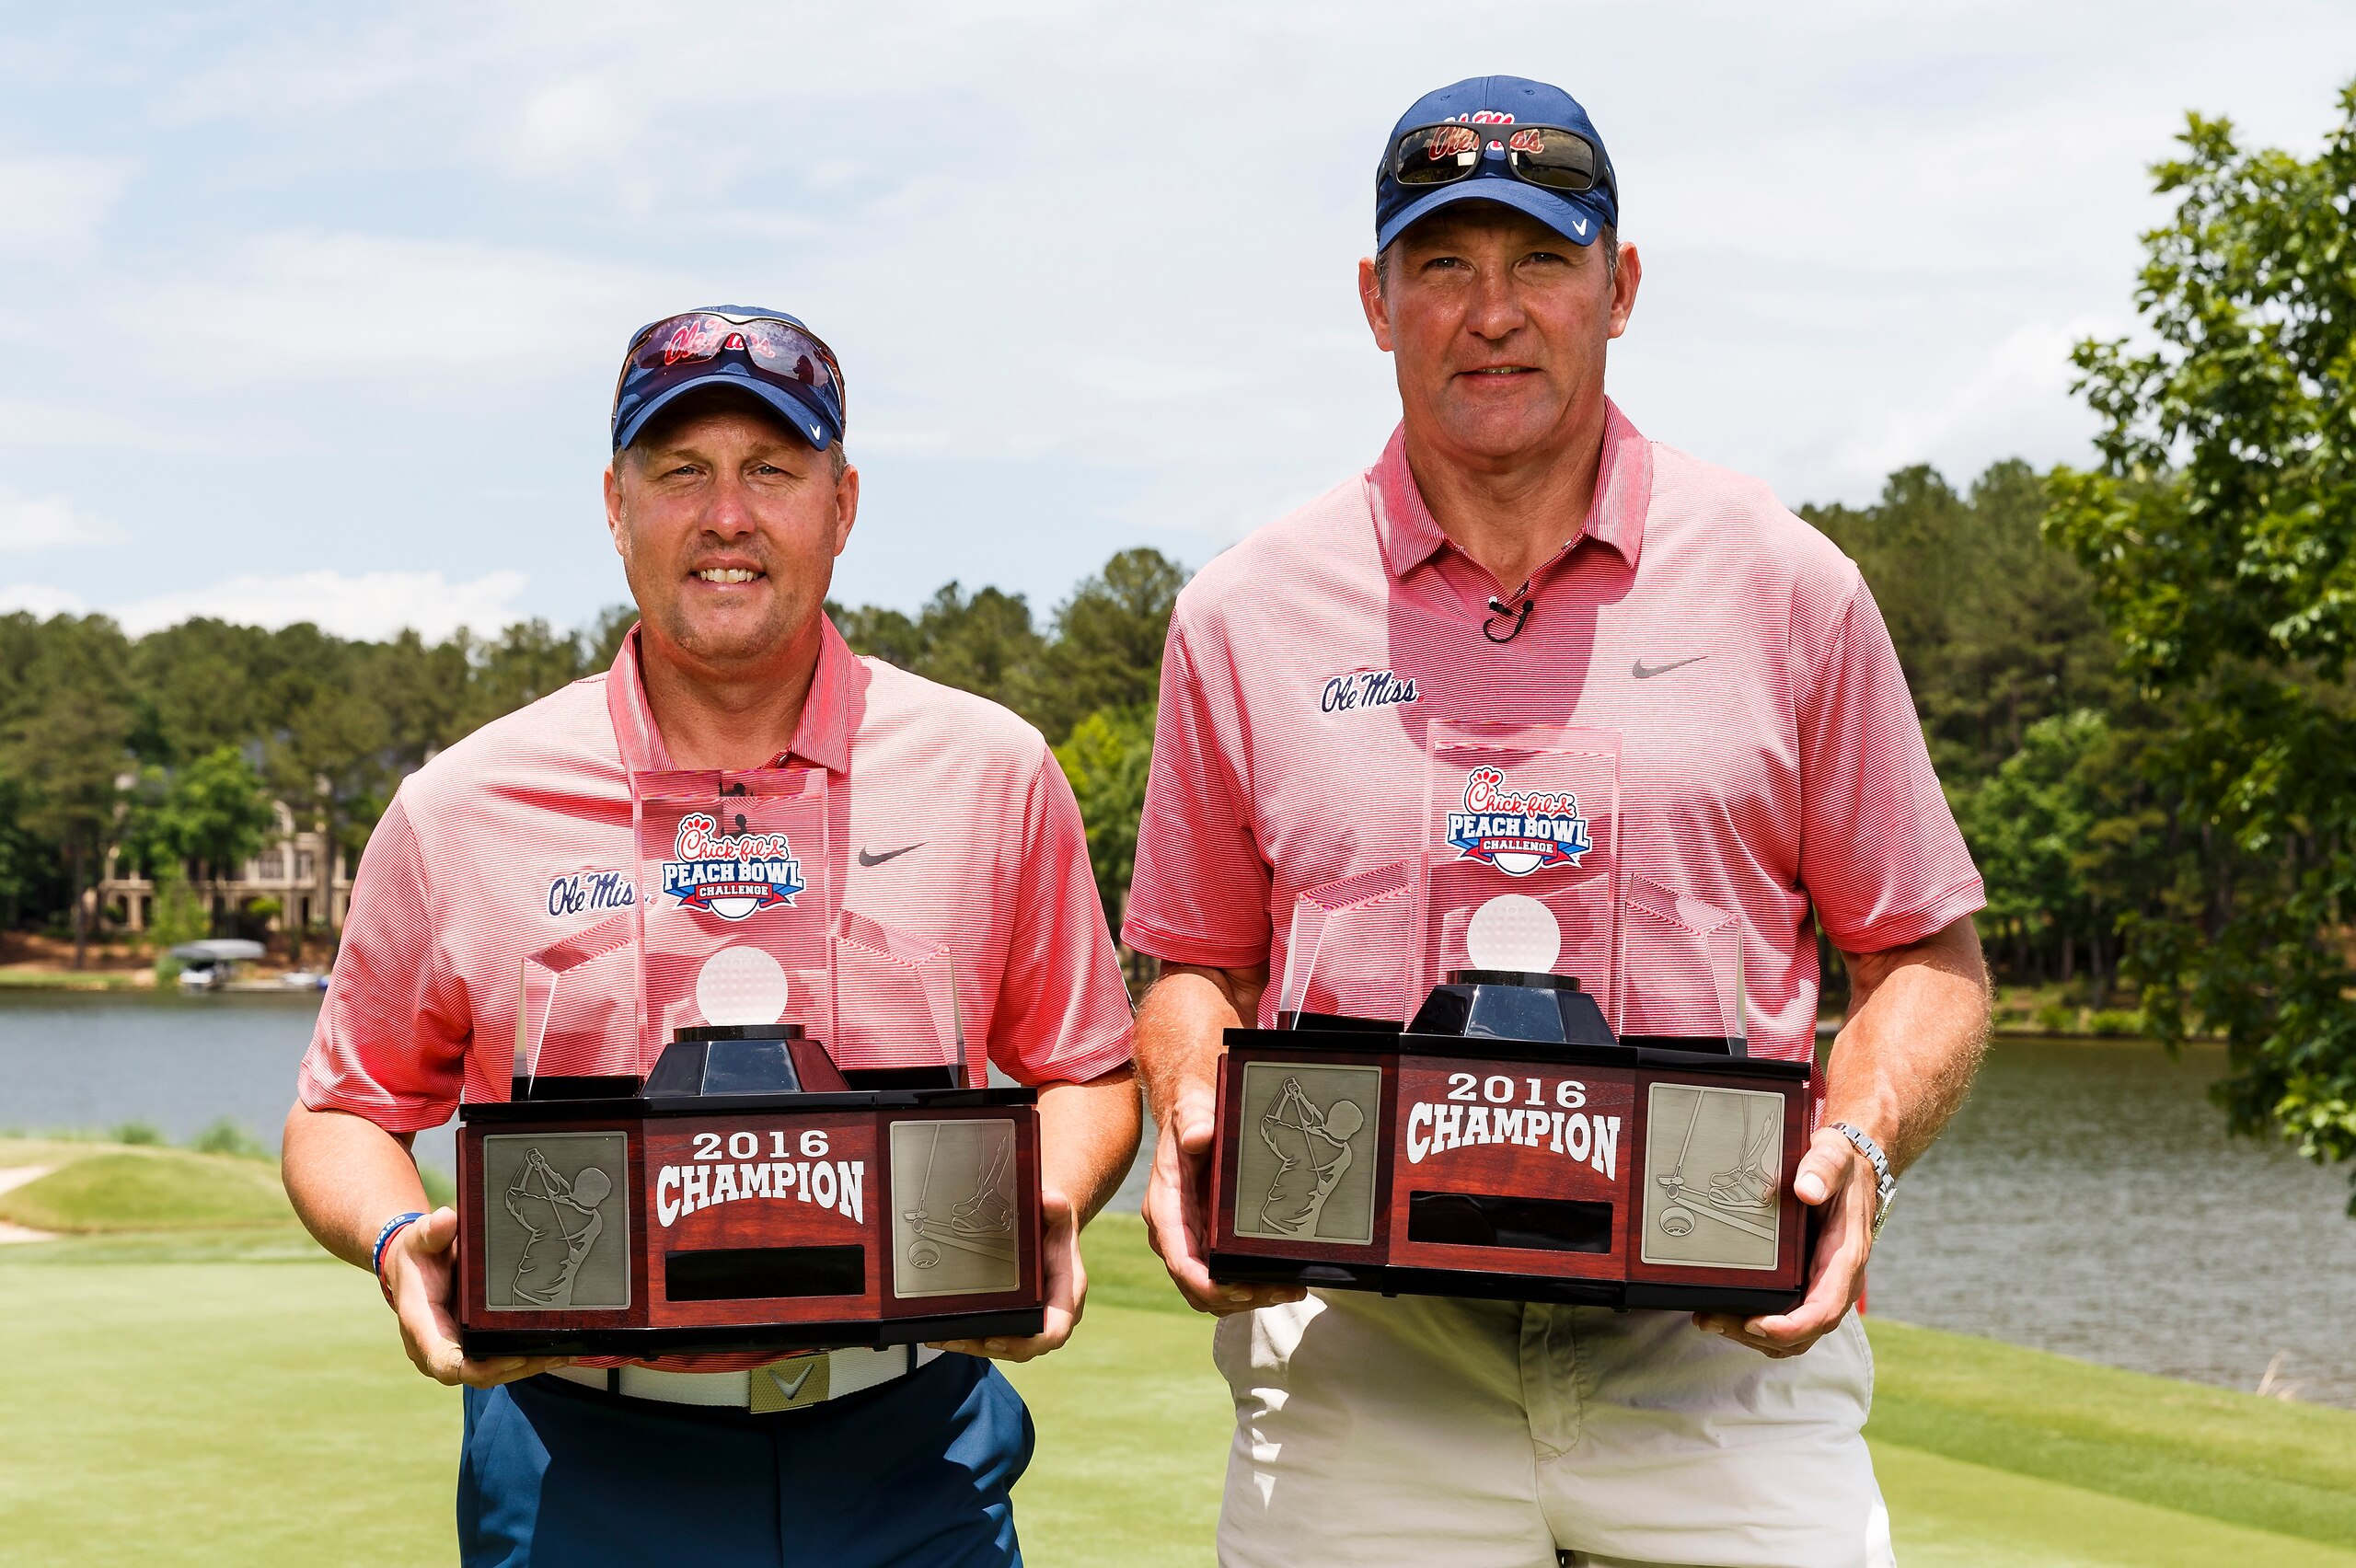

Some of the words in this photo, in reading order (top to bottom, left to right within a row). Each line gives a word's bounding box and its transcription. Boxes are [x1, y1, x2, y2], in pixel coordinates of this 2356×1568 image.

[1322, 675, 1358, 713] Ole
[1360, 671, 1418, 707] Miss
[1467, 771, 1574, 819] Chick-fil-A
[680, 818, 787, 862] Chick-fil-A
[1449, 814, 1521, 841] PEACH
[1523, 818, 1590, 850] BOWL
[1483, 839, 1554, 854] CHALLENGE
[549, 876, 586, 916] Ole
[587, 871, 648, 907] Mis
[663, 863, 734, 891] PEACH
[738, 862, 804, 889] BOWL
[699, 884, 769, 897] CHALLENGE
[1447, 1072, 1587, 1109] 2016
[692, 1130, 829, 1160] 2016
[1406, 1101, 1621, 1182] CHAMPION
[656, 1160, 864, 1228] CHAMPION
